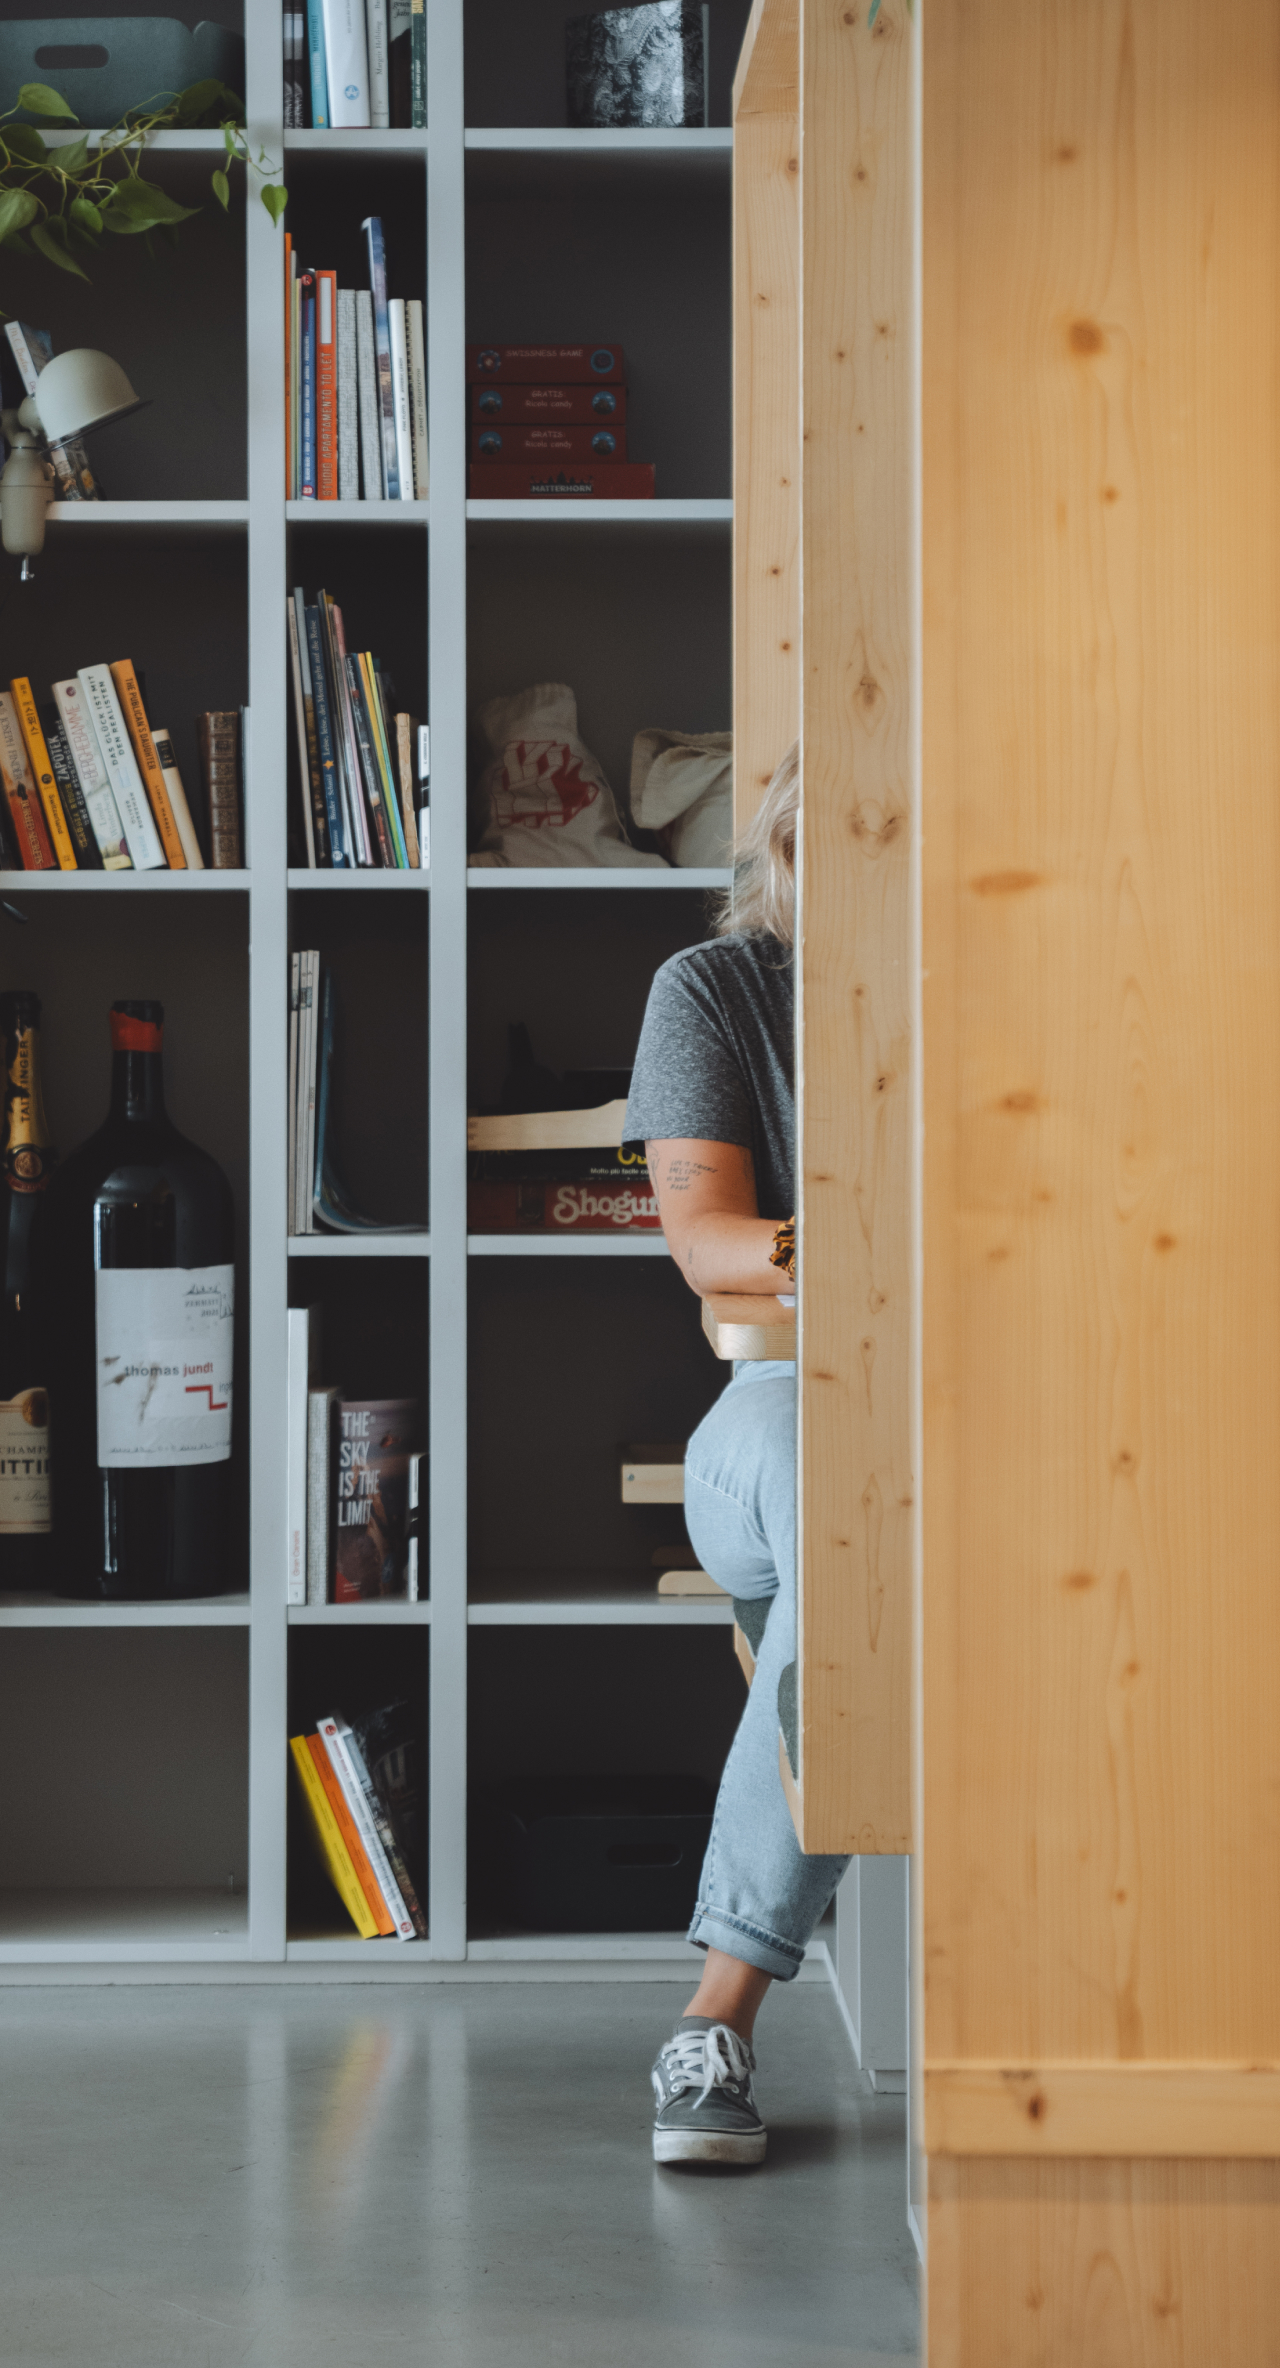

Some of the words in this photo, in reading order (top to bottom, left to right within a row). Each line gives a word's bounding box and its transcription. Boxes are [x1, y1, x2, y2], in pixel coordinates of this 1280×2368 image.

[321, 352, 332, 371] LET
[505, 349, 557, 357] SWISSNESS
[559, 349, 584, 357] GAME
[321, 374, 332, 385] TO
[416, 368, 424, 407] DÉGUSTATION
[531, 390, 567, 398] GRATIS:
[550, 400, 573, 409] candy
[321, 389, 332, 459] APARTAMENTO
[531, 430, 566, 438] GRATIS:
[550, 440, 572, 450] candy
[322, 462, 333, 496] STUDIO
[530, 484, 592, 493] MATTERHORN
[309, 619, 318, 638] Reise
[311, 639, 319, 651] die
[312, 651, 320, 664] auf
[314, 665, 325, 680] geht
[88, 675, 97, 692] MIT
[316, 680, 325, 703] Mond
[93, 694, 102, 710] IST
[99, 681, 118, 733] REALISTEN
[318, 704, 326, 715] der
[98, 713, 112, 745] GLÜCK
[125, 678, 135, 692] THE
[130, 692, 148, 734] PUBLICAN'S
[141, 733, 156, 770] DAUGHTER
[1, 717, 14, 747] JOSEPH
[9, 751, 23, 781] FINDER
[115, 737, 125, 756] DEN
[321, 735, 331, 756] Leise,
[47, 735, 70, 782] ZAPOTEK
[109, 747, 118, 766] DAS
[326, 774, 335, 795] Schmid
[65, 783, 76, 809] RUSCH
[75, 790, 84, 806] die
[49, 795, 63, 834] Switzerland
[80, 809, 89, 826] und
[94, 803, 107, 826] Linda
[101, 793, 119, 837] Winterberg
[328, 800, 337, 820] Binder
[22, 800, 34, 831] BURIED
[30, 831, 44, 864] SECRETS
[73, 811, 88, 848] CLAUDIA
[19, 1040, 30, 1123] TAITINGER
[124, 1364, 180, 1376] thomas
[183, 1362, 214, 1378] jundt
[342, 1411, 371, 1438] THE
[340, 1441, 370, 1468] SKY
[338, 1471, 354, 1497] IS
[359, 1469, 381, 1495] THE
[338, 1499, 373, 1527] LIMIT
